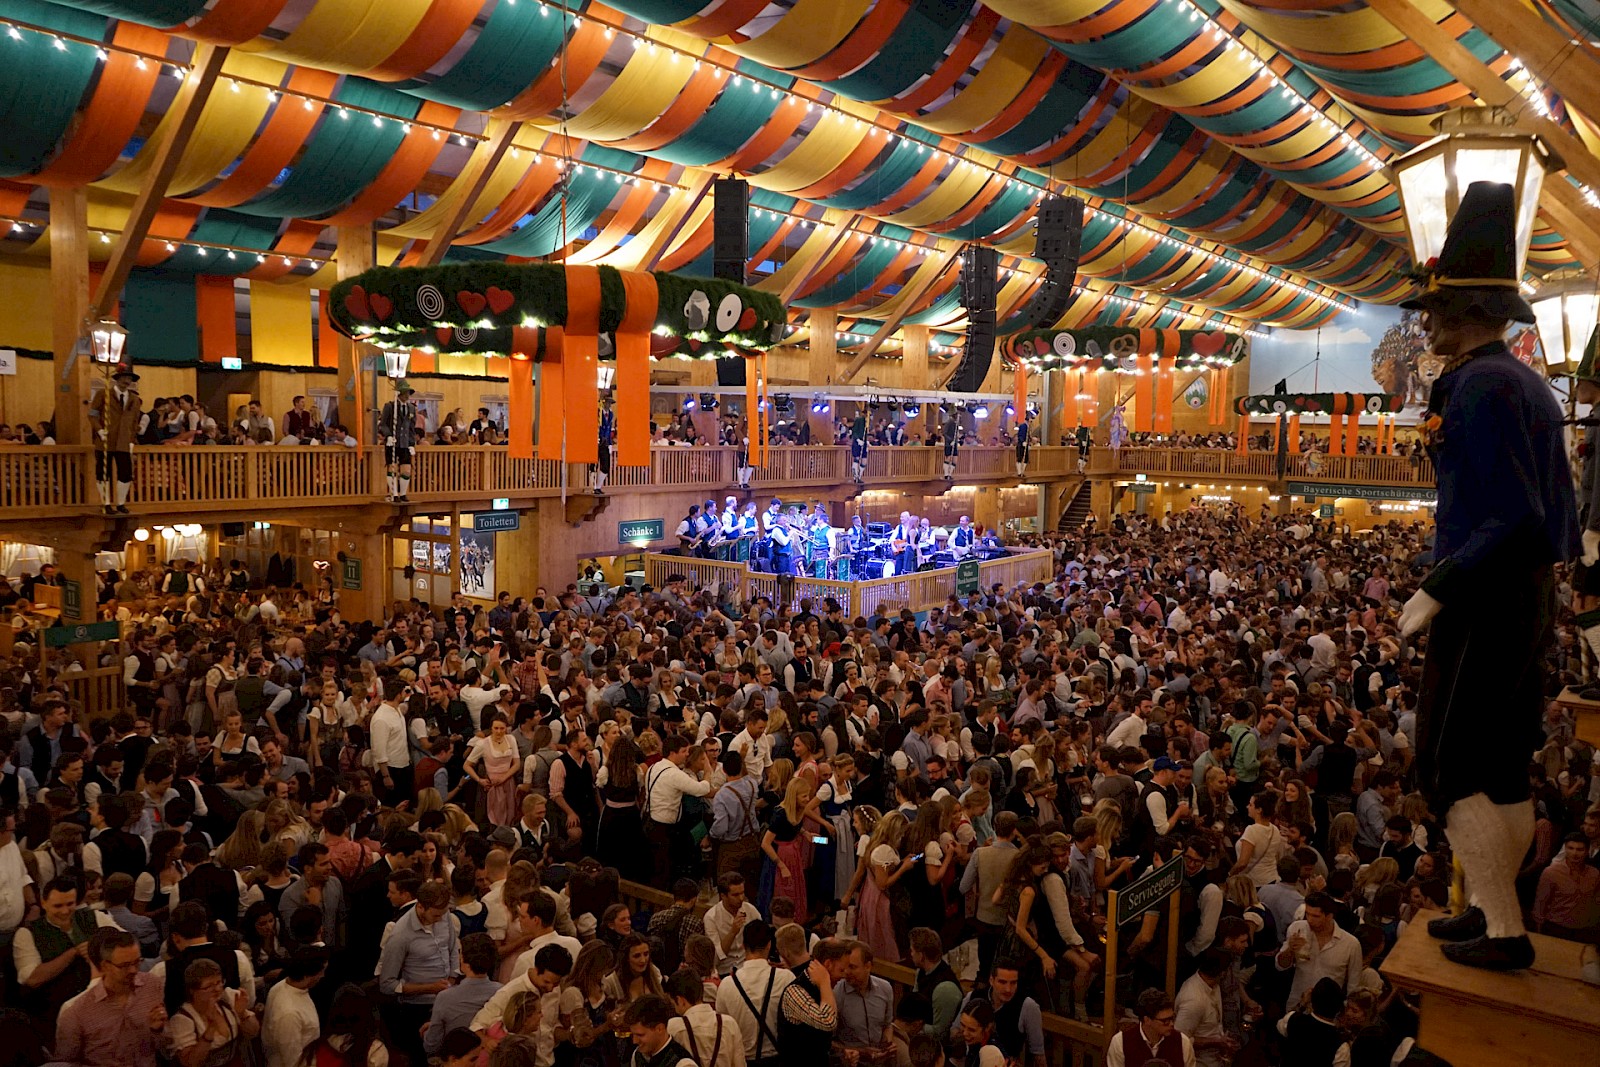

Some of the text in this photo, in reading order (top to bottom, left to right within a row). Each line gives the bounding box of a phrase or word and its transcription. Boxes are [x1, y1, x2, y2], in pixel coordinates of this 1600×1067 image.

[1303, 485, 1352, 496] Bayerische
[479, 518, 514, 528] Toiletten
[623, 525, 653, 538] Schänke
[1128, 870, 1176, 911] Servicegang
